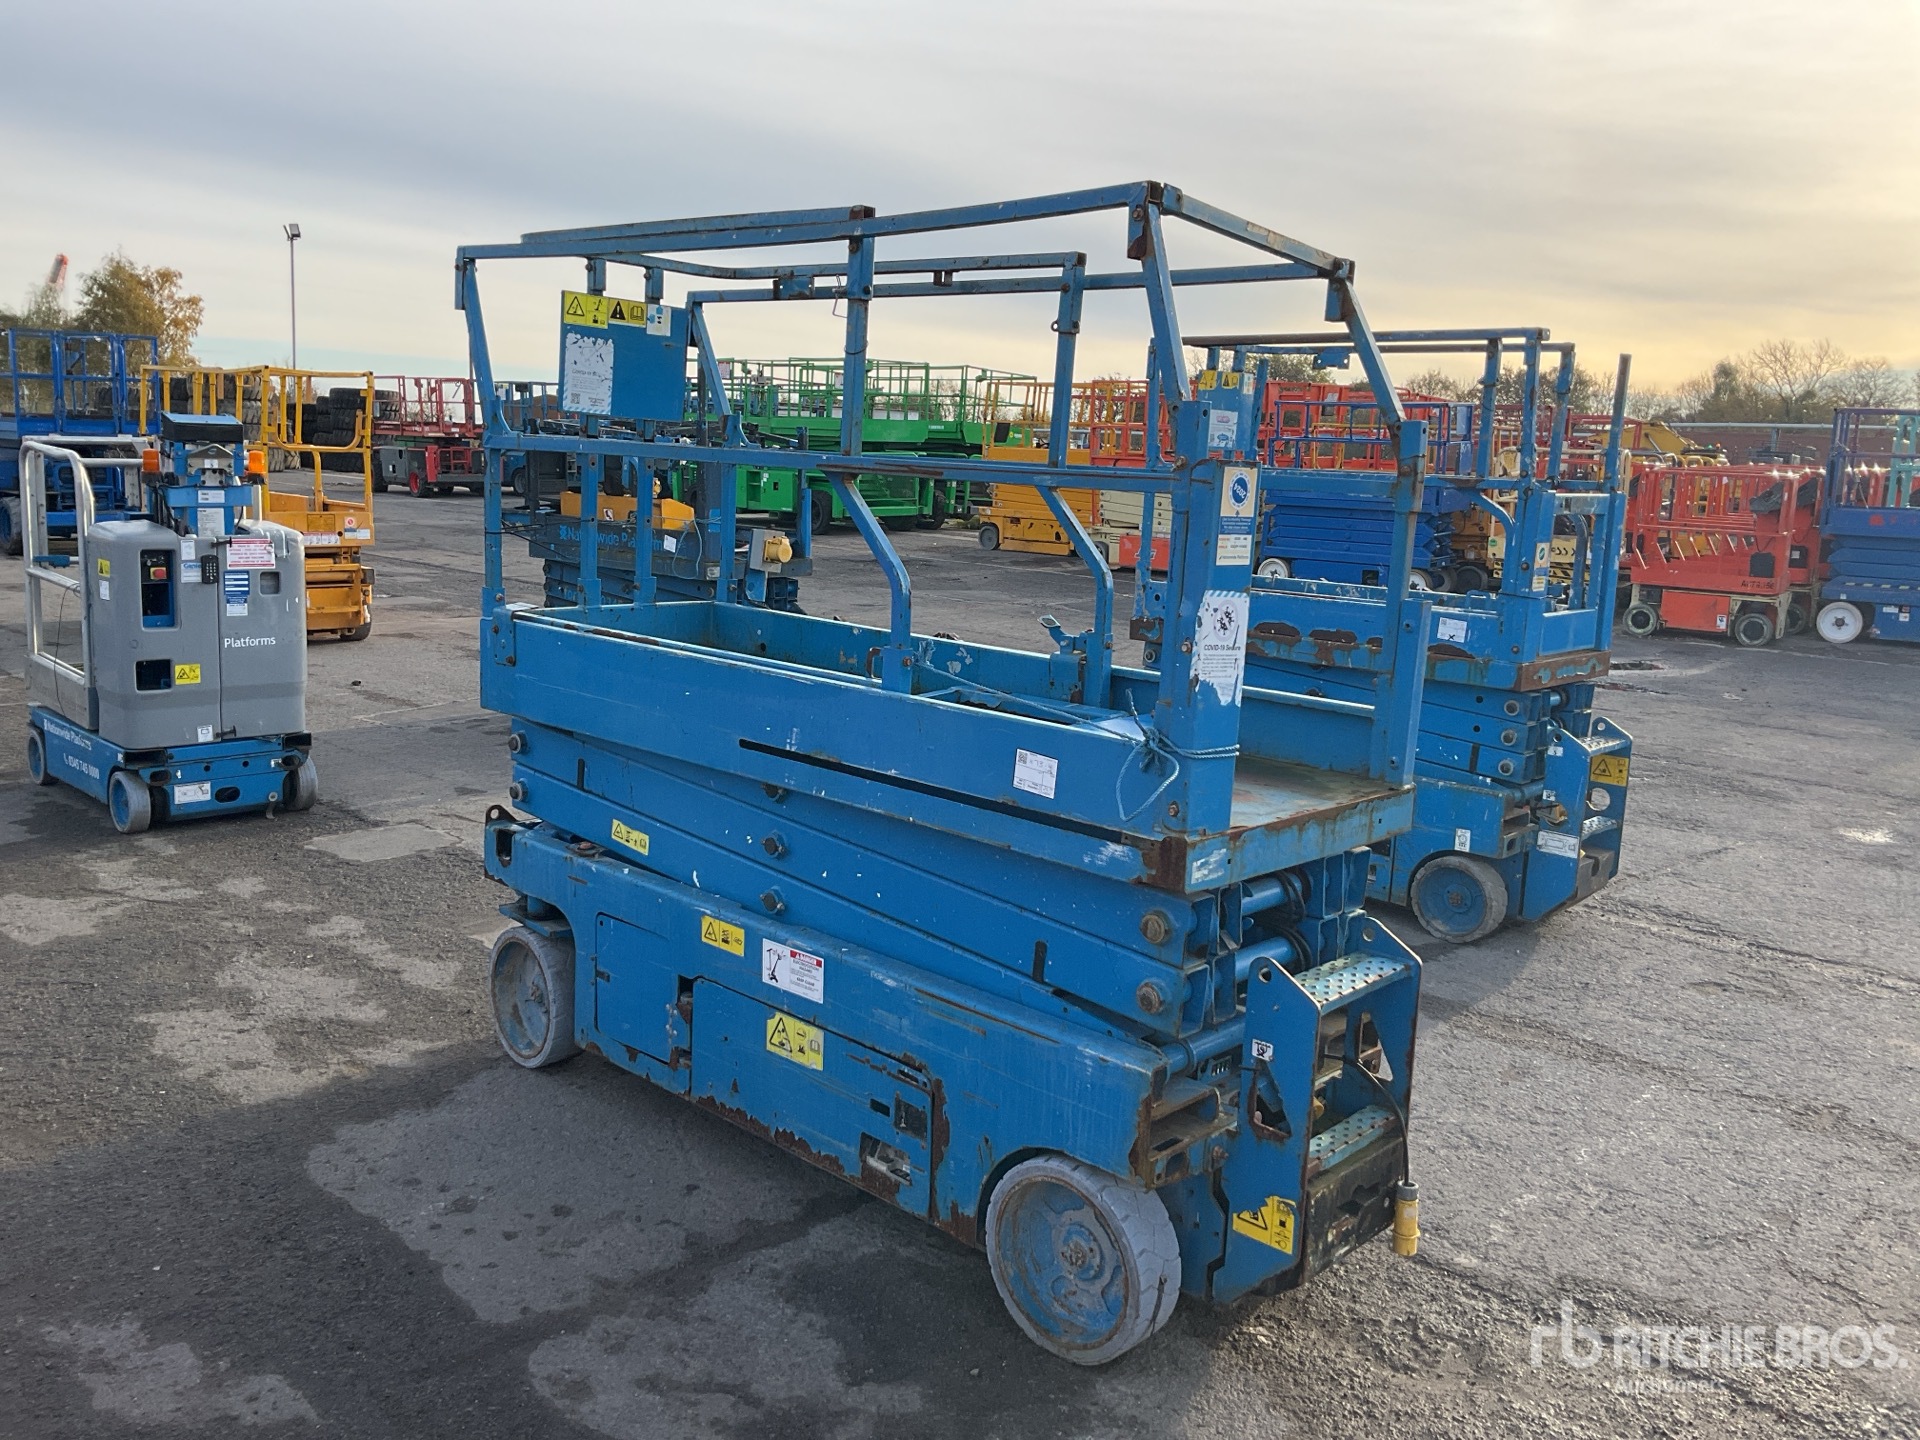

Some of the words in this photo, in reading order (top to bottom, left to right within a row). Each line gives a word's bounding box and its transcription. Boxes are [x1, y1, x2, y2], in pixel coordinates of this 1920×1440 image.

[1233, 483, 1247, 499] 2024
[224, 636, 276, 648] Platforms
[1203, 644, 1226, 652] COVID-19
